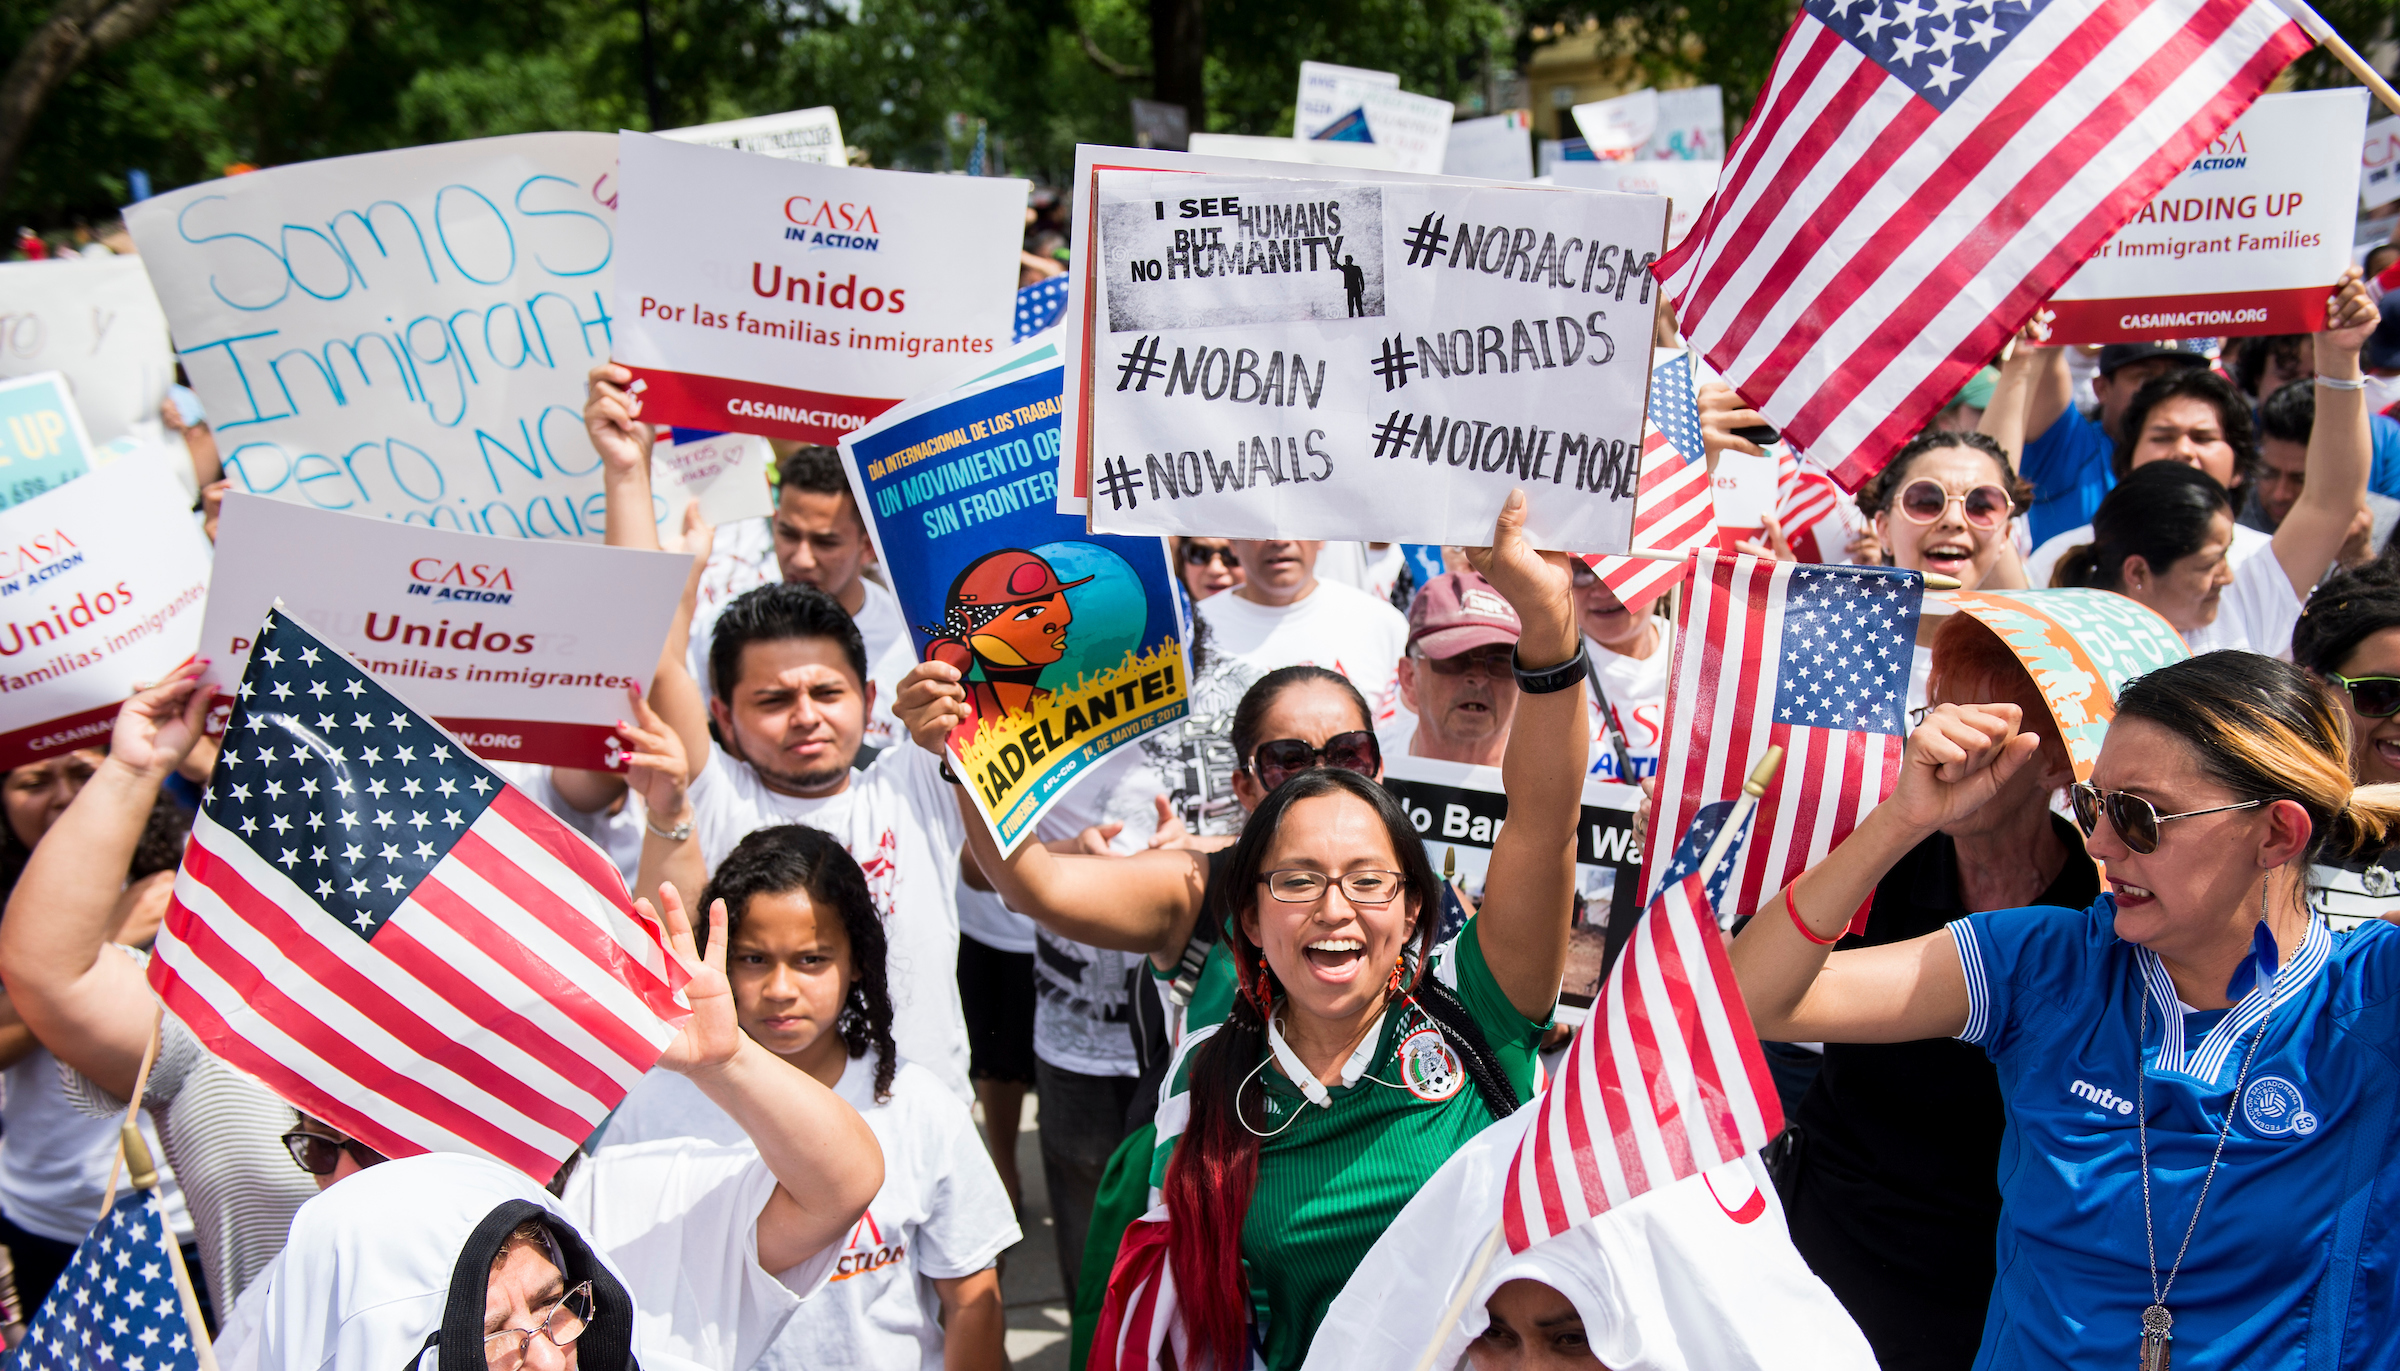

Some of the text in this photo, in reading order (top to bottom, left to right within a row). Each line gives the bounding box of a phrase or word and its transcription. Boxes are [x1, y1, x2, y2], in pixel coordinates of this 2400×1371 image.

[2191, 156, 2248, 171] ACTION
[784, 195, 881, 234] CASA
[1155, 196, 1342, 241] I SEE HUMANS
[2127, 192, 2303, 224] ANDING UP
[785, 227, 879, 251] IN ACTION
[1130, 235, 1344, 282] NO HUMANITY
[1174, 227, 1222, 252] BUT
[1402, 210, 1657, 304] #NORACISM
[2118, 236, 2232, 260] Immigrant
[2238, 229, 2321, 251] Families
[752, 262, 906, 314] Unidos
[640, 297, 994, 358] Por las familias inmigrantes
[2119, 307, 2268, 330] CASAINACTION.ORG
[1116, 335, 1326, 410] #NOBAN
[1371, 311, 1615, 393] #NORAIDS
[867, 394, 1063, 482] DÍA INTERNACIONAL DE LOS TRABAJ
[876, 484, 903, 518] UN
[901, 439, 1033, 508] MOVIMIENTO
[1096, 428, 1334, 511] #NOWALLS
[922, 467, 1059, 540] SIN FRONTER
[28, 551, 84, 588] ACTION
[409, 557, 516, 591] CASA
[407, 584, 514, 606] IN ACTION
[0, 581, 133, 657] Unidos
[364, 611, 536, 656] Unidos
[348, 652, 458, 681] amilias
[465, 663, 632, 689] inmigrantes
[977, 666, 1178, 809] ¡ADELANTE!
[1098, 740, 1111, 753] DE
[1111, 724, 1140, 745] MAYO
[1141, 716, 1156, 730] DE
[1156, 704, 1183, 723] 2017
[1042, 760, 1077, 793] AFL-CIO
[2070, 1080, 2134, 1115] mitre
[2295, 1116, 2314, 1131] ES
